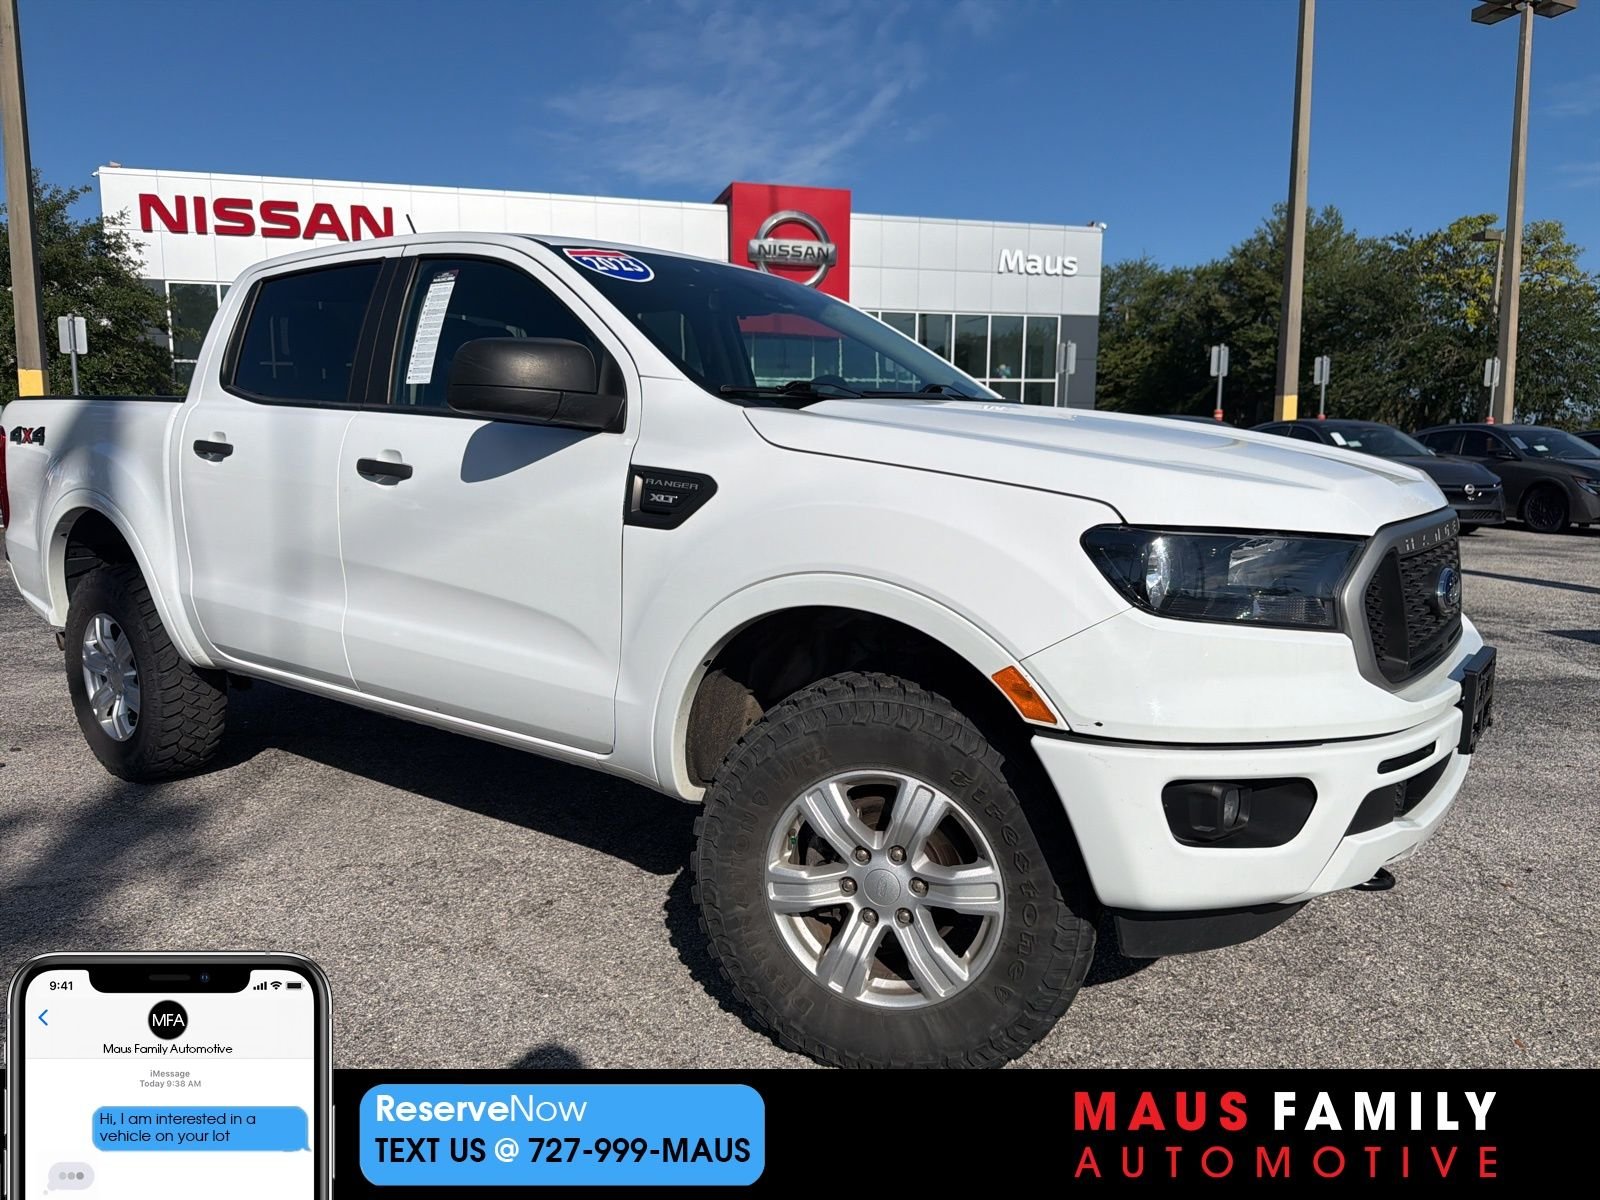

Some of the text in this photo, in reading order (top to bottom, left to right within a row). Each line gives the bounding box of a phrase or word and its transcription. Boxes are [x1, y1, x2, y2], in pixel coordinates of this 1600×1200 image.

[139, 193, 394, 242] NISSAN
[758, 244, 829, 260] NISSAN
[998, 249, 1078, 277] Maus
[645, 478, 699, 490] RANGER
[650, 493, 674, 504] XLT
